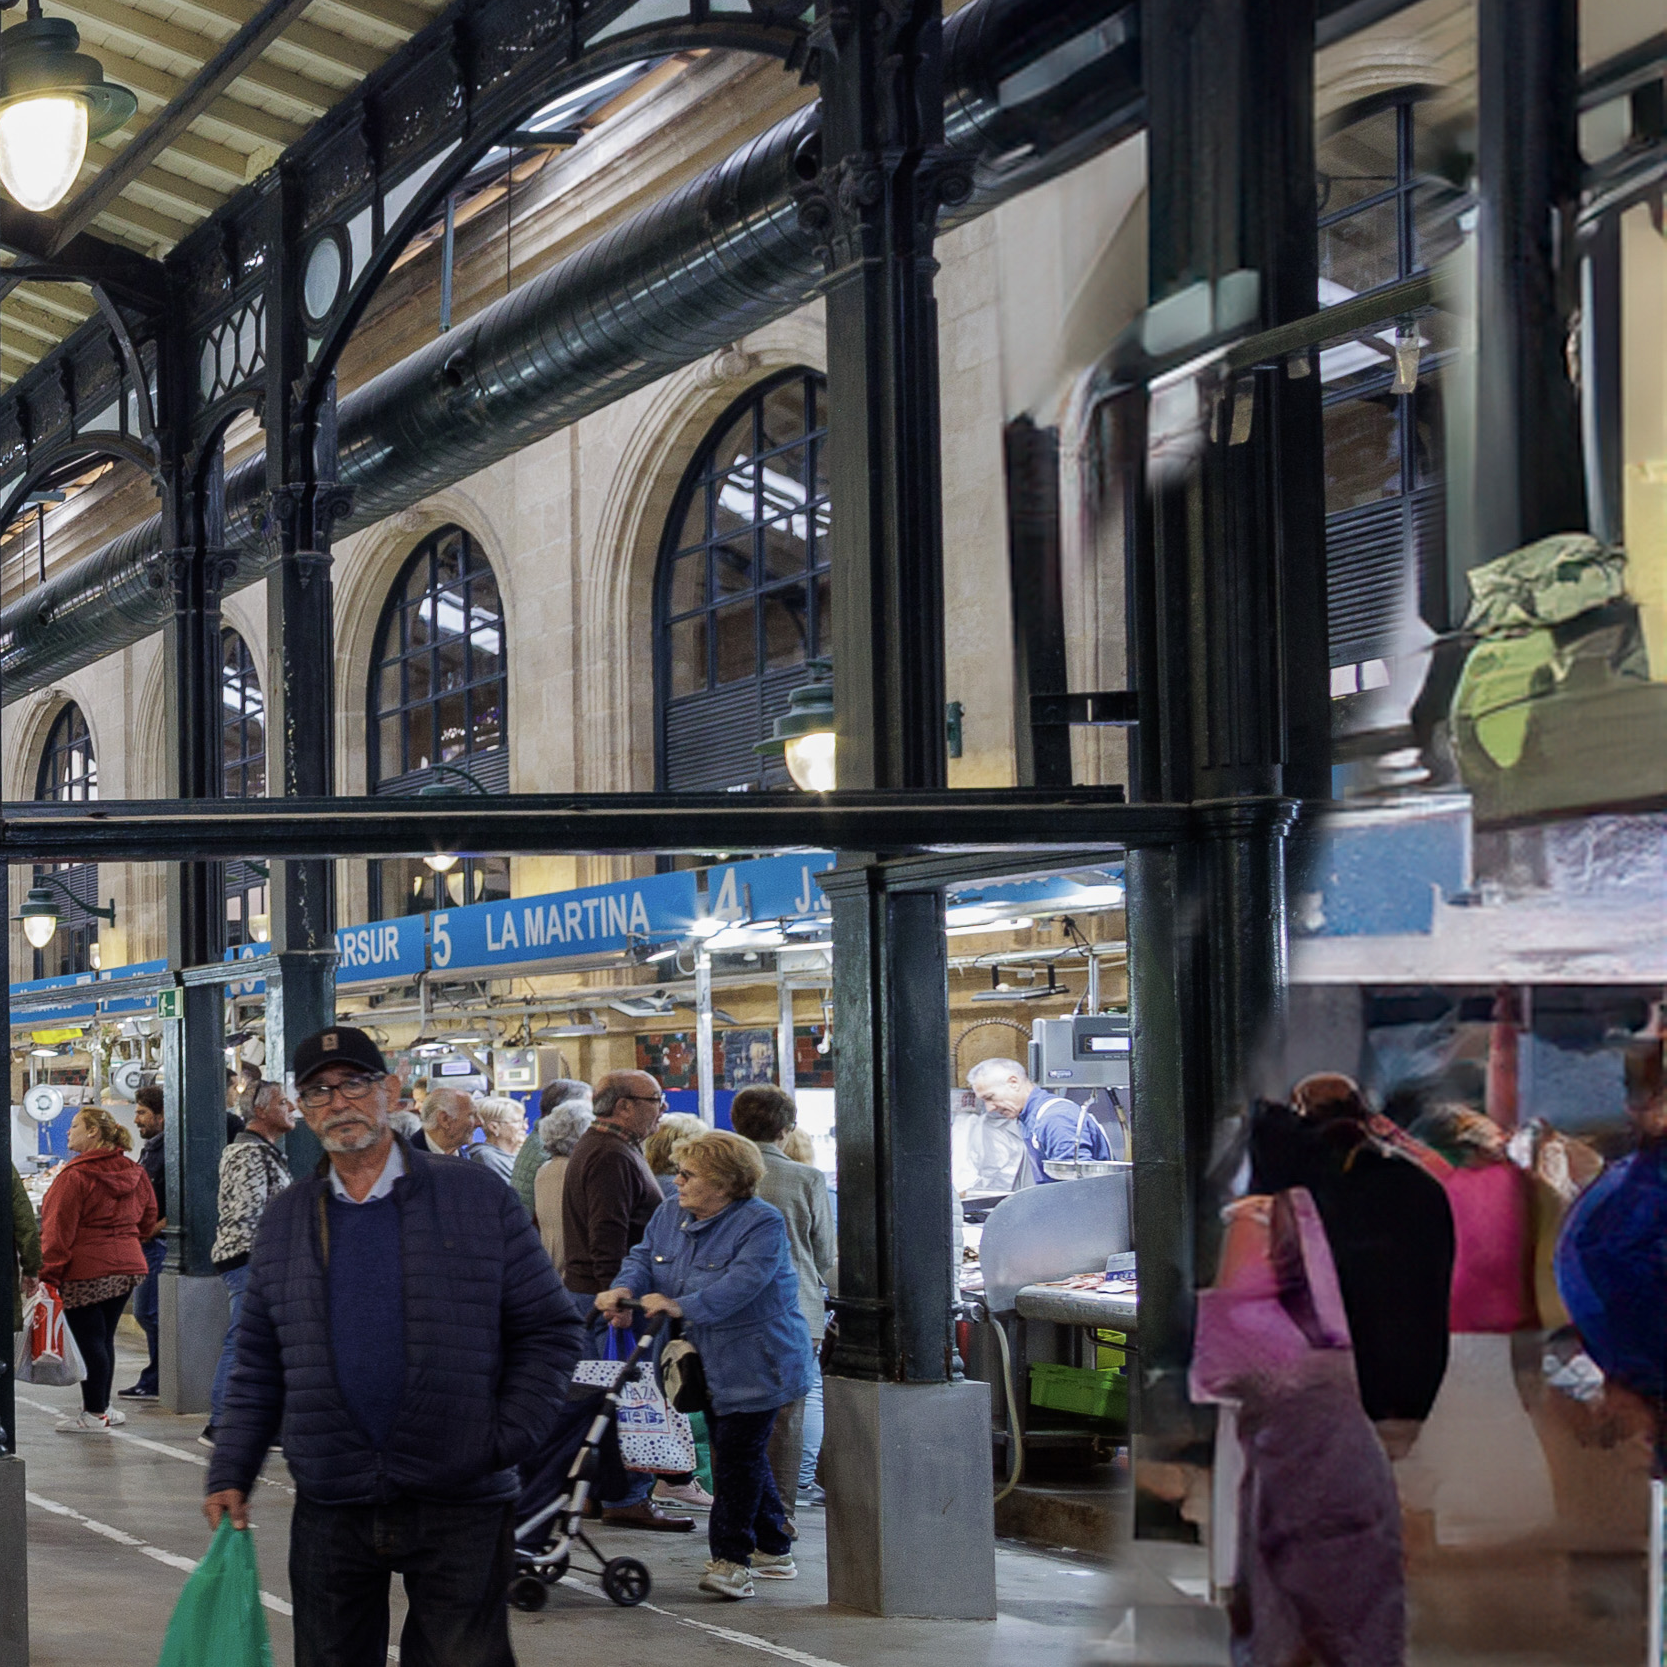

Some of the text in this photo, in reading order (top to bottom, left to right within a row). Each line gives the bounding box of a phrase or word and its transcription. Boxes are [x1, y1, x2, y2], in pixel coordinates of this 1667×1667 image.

[486, 891, 651, 952] LA MARTINA
[713, 867, 743, 922] 4
[433, 913, 452, 968] 5
